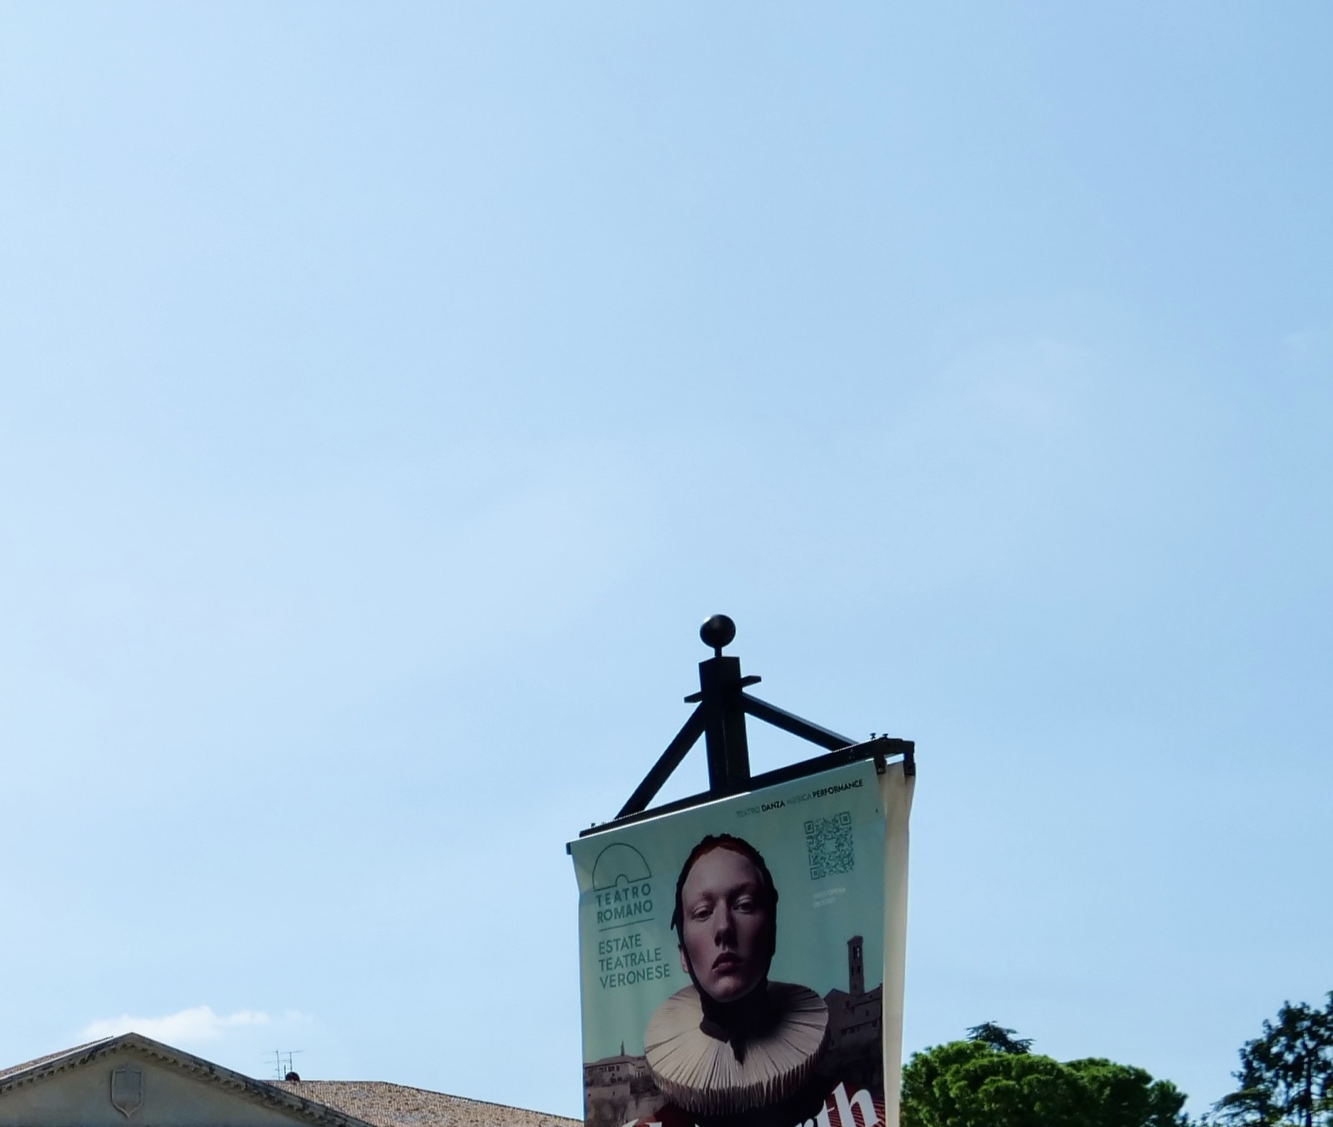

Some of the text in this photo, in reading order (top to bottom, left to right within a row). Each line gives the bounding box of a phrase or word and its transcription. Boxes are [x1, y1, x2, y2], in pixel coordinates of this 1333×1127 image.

[761, 801, 785, 812] DANZA
[812, 779, 864, 799] PERFORMANCE
[596, 883, 651, 908] TEATRO
[597, 899, 653, 924] ROMANO
[598, 934, 642, 955] ESTATE
[598, 947, 662, 972] TEATRALE
[599, 964, 671, 989] VERONESE
